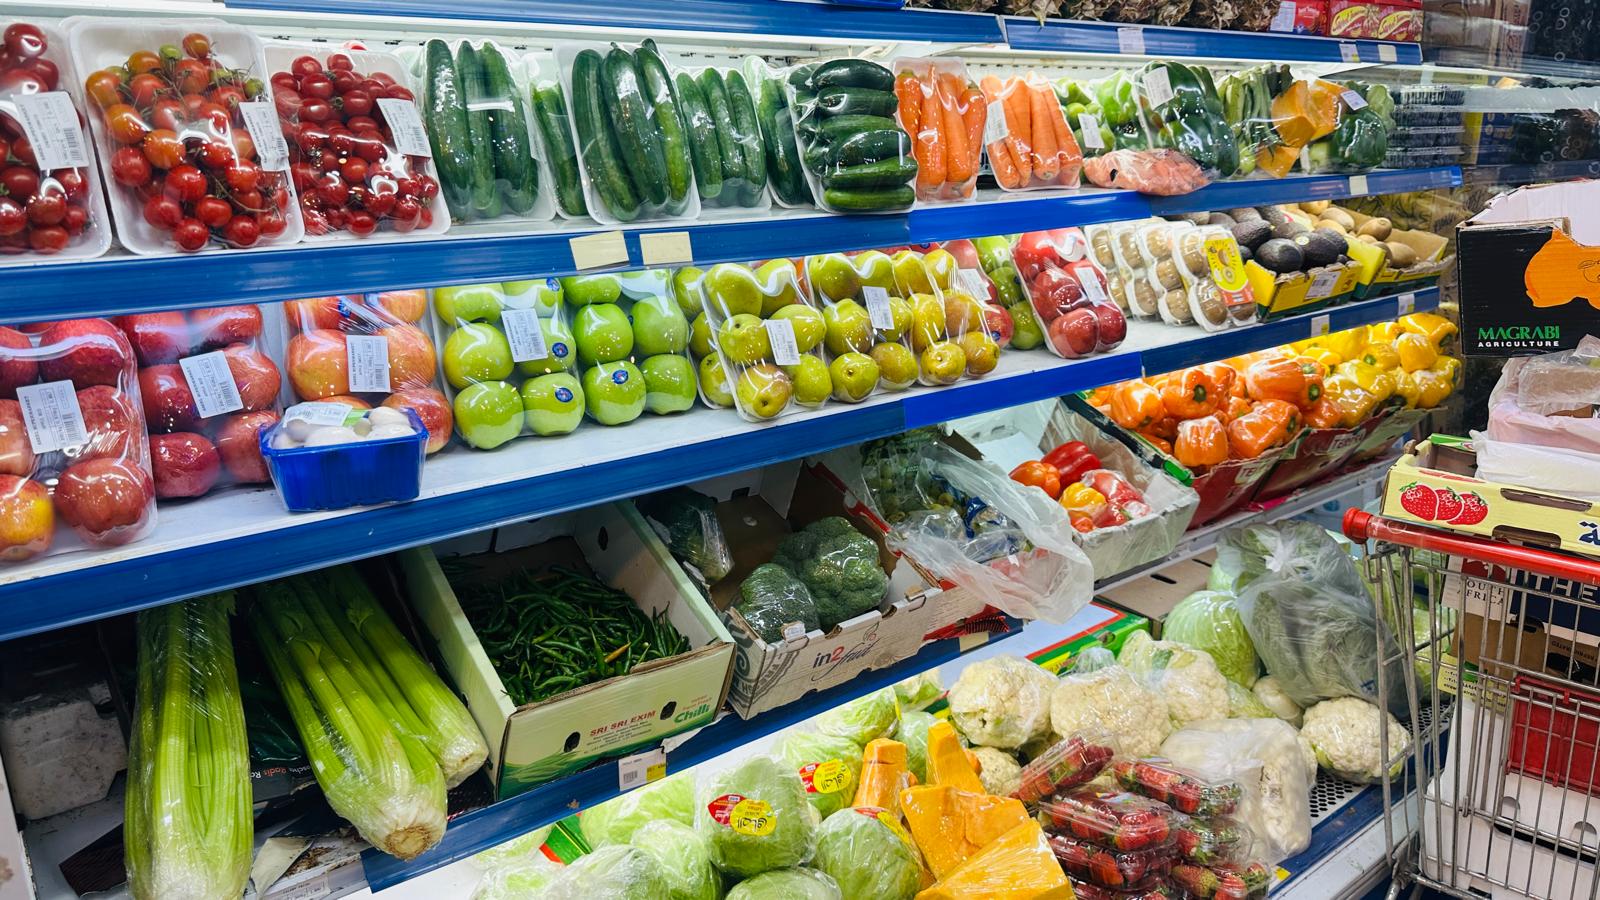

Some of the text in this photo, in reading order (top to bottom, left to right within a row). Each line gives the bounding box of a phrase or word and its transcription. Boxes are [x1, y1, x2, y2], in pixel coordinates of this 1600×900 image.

[1478, 326, 1560, 340] MAGRABI
[589, 710, 656, 738] SRI SRI EXIM
